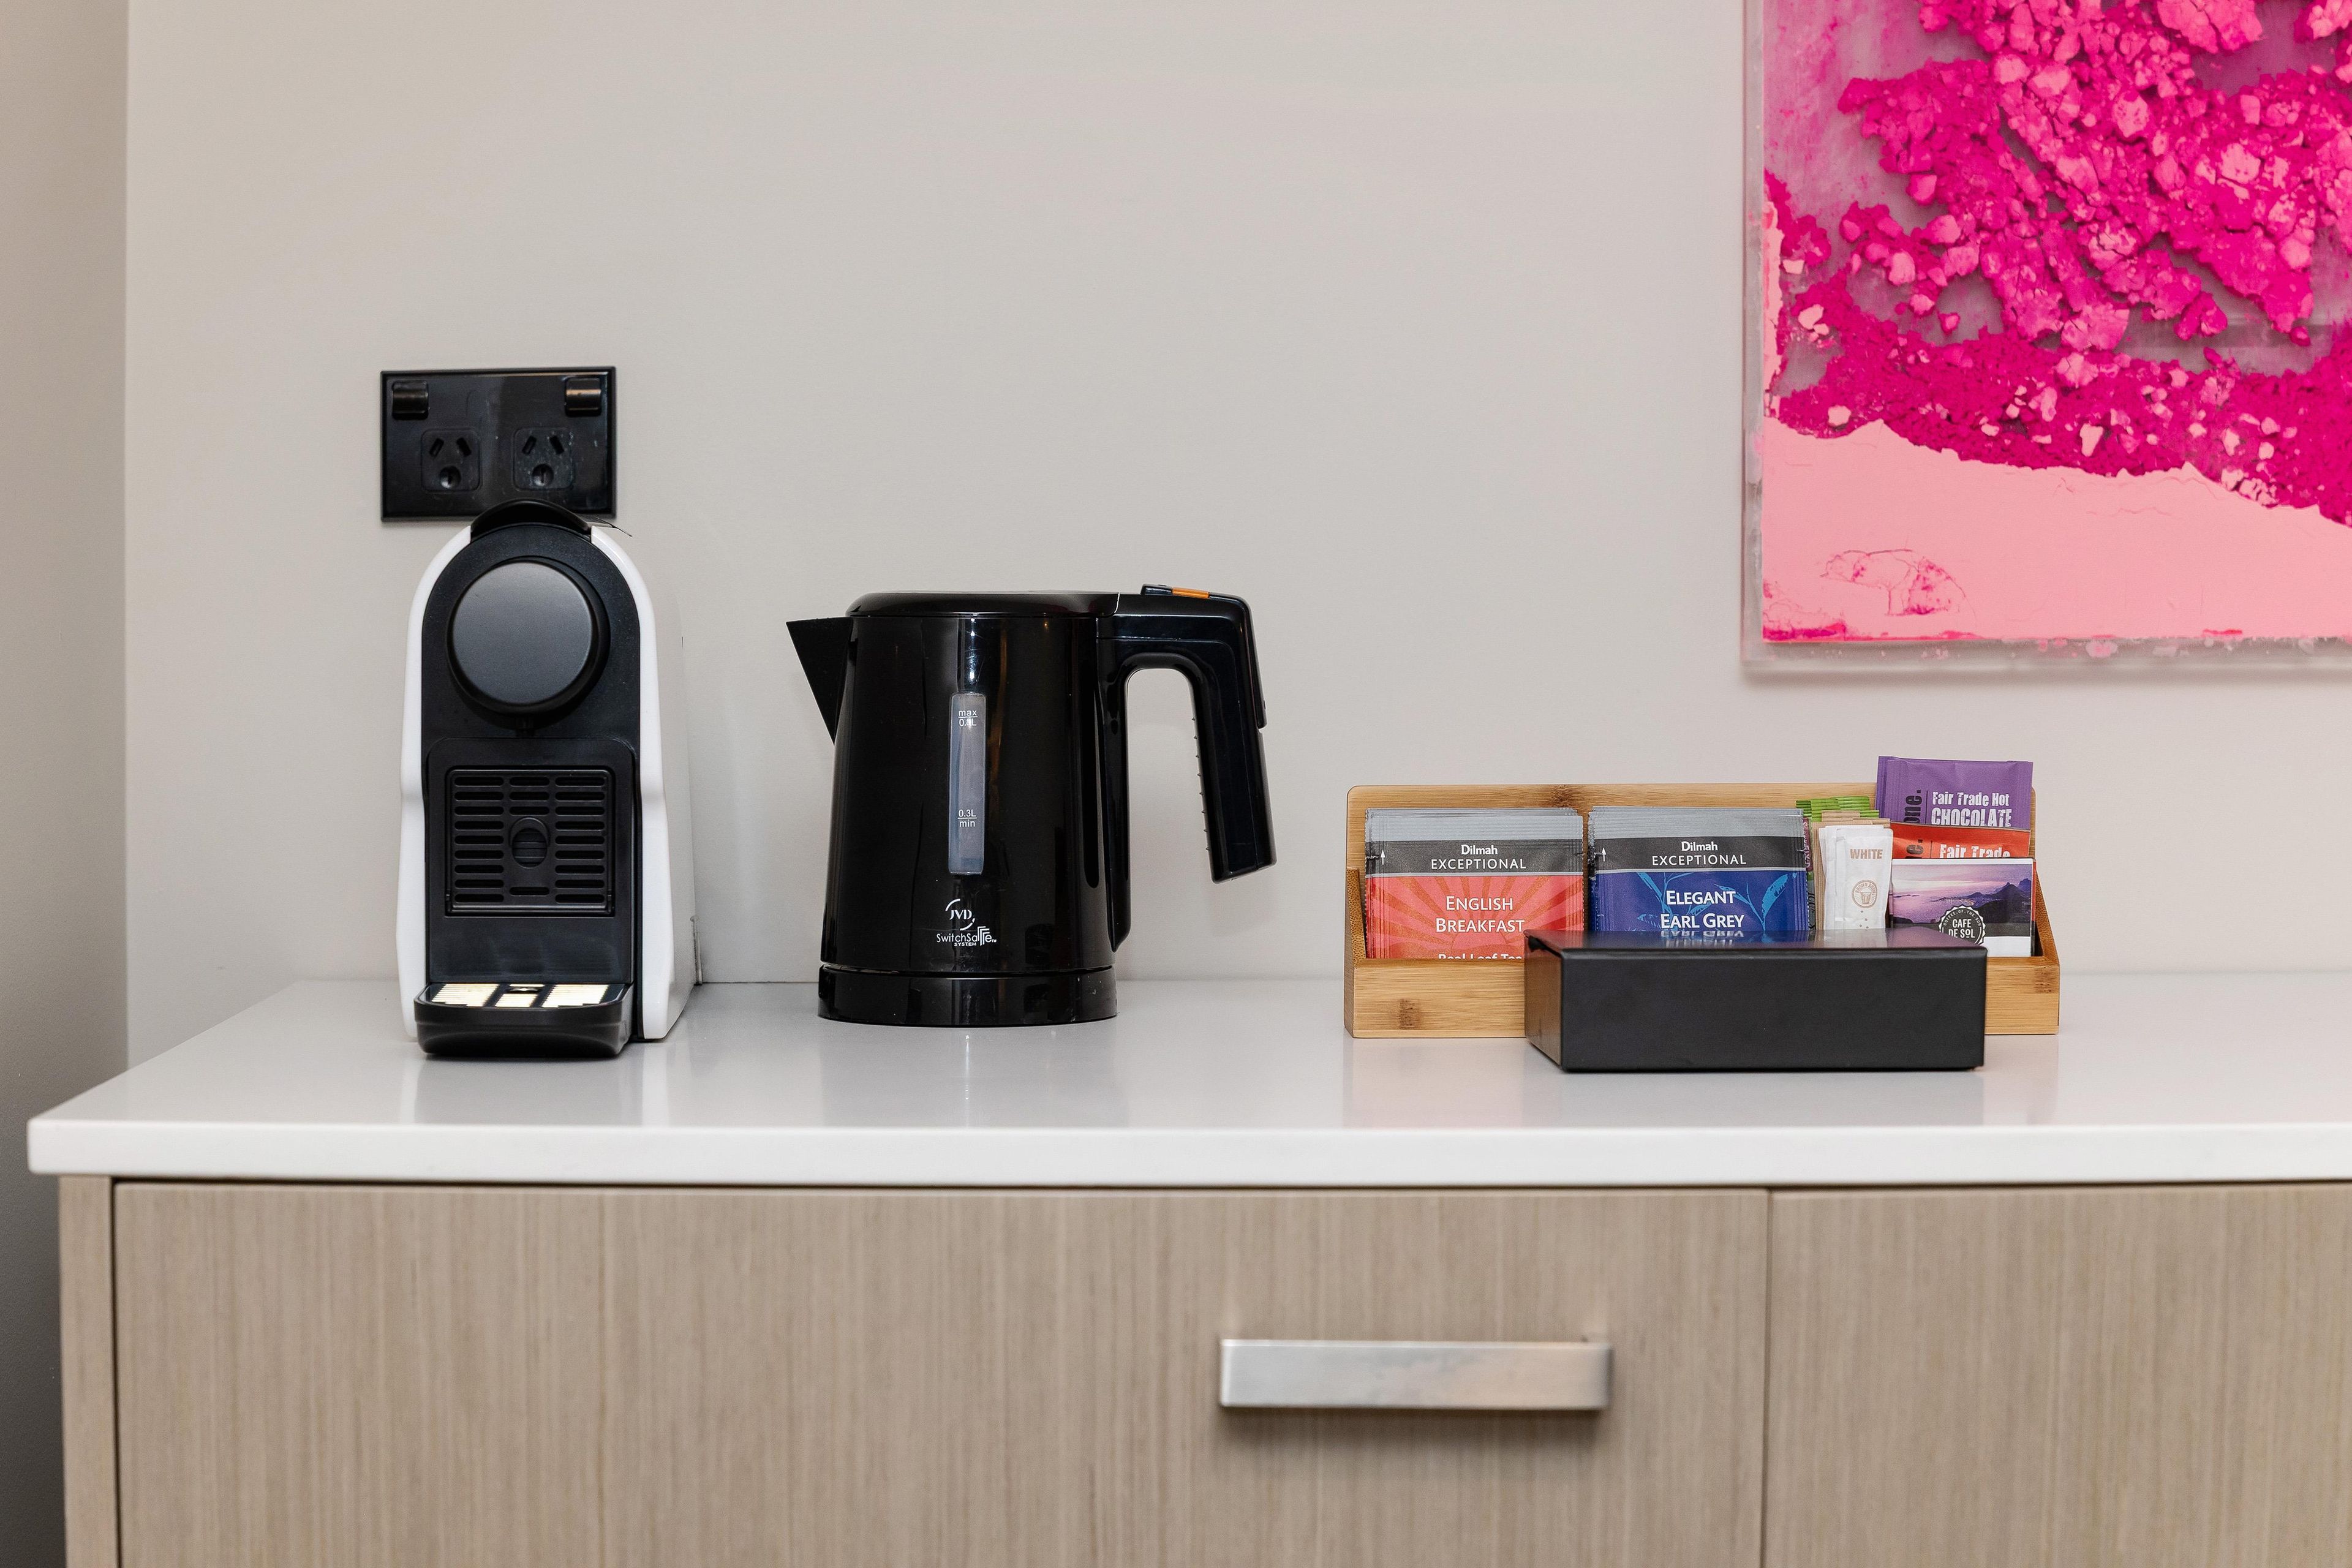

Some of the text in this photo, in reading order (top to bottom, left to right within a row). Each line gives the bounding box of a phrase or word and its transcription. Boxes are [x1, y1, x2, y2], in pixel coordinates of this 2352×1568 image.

[959, 718, 977, 726] 0.8L
[1932, 791, 2010, 807] Fair Trade Hot
[958, 809, 977, 818] 0.3L
[1931, 807, 2012, 827] CHOCOLATE
[1461, 844, 1498, 855] Dilmah
[1681, 841, 1718, 851] Dilmah
[1939, 844, 1967, 858] Fair
[1850, 848, 1883, 859] WHITE
[1431, 859, 1526, 870] EXCEPTIONAL
[1652, 854, 1747, 866] EXCEPTIONAL
[1446, 895, 1513, 911] ENGLISH
[1666, 890, 1736, 905] ELEGANT
[1436, 918, 1525, 933] BREAKFAST
[1660, 913, 1745, 929] EARL GREY
[1952, 919, 1972, 928] CAFE
[1948, 929, 1958, 938] DE
